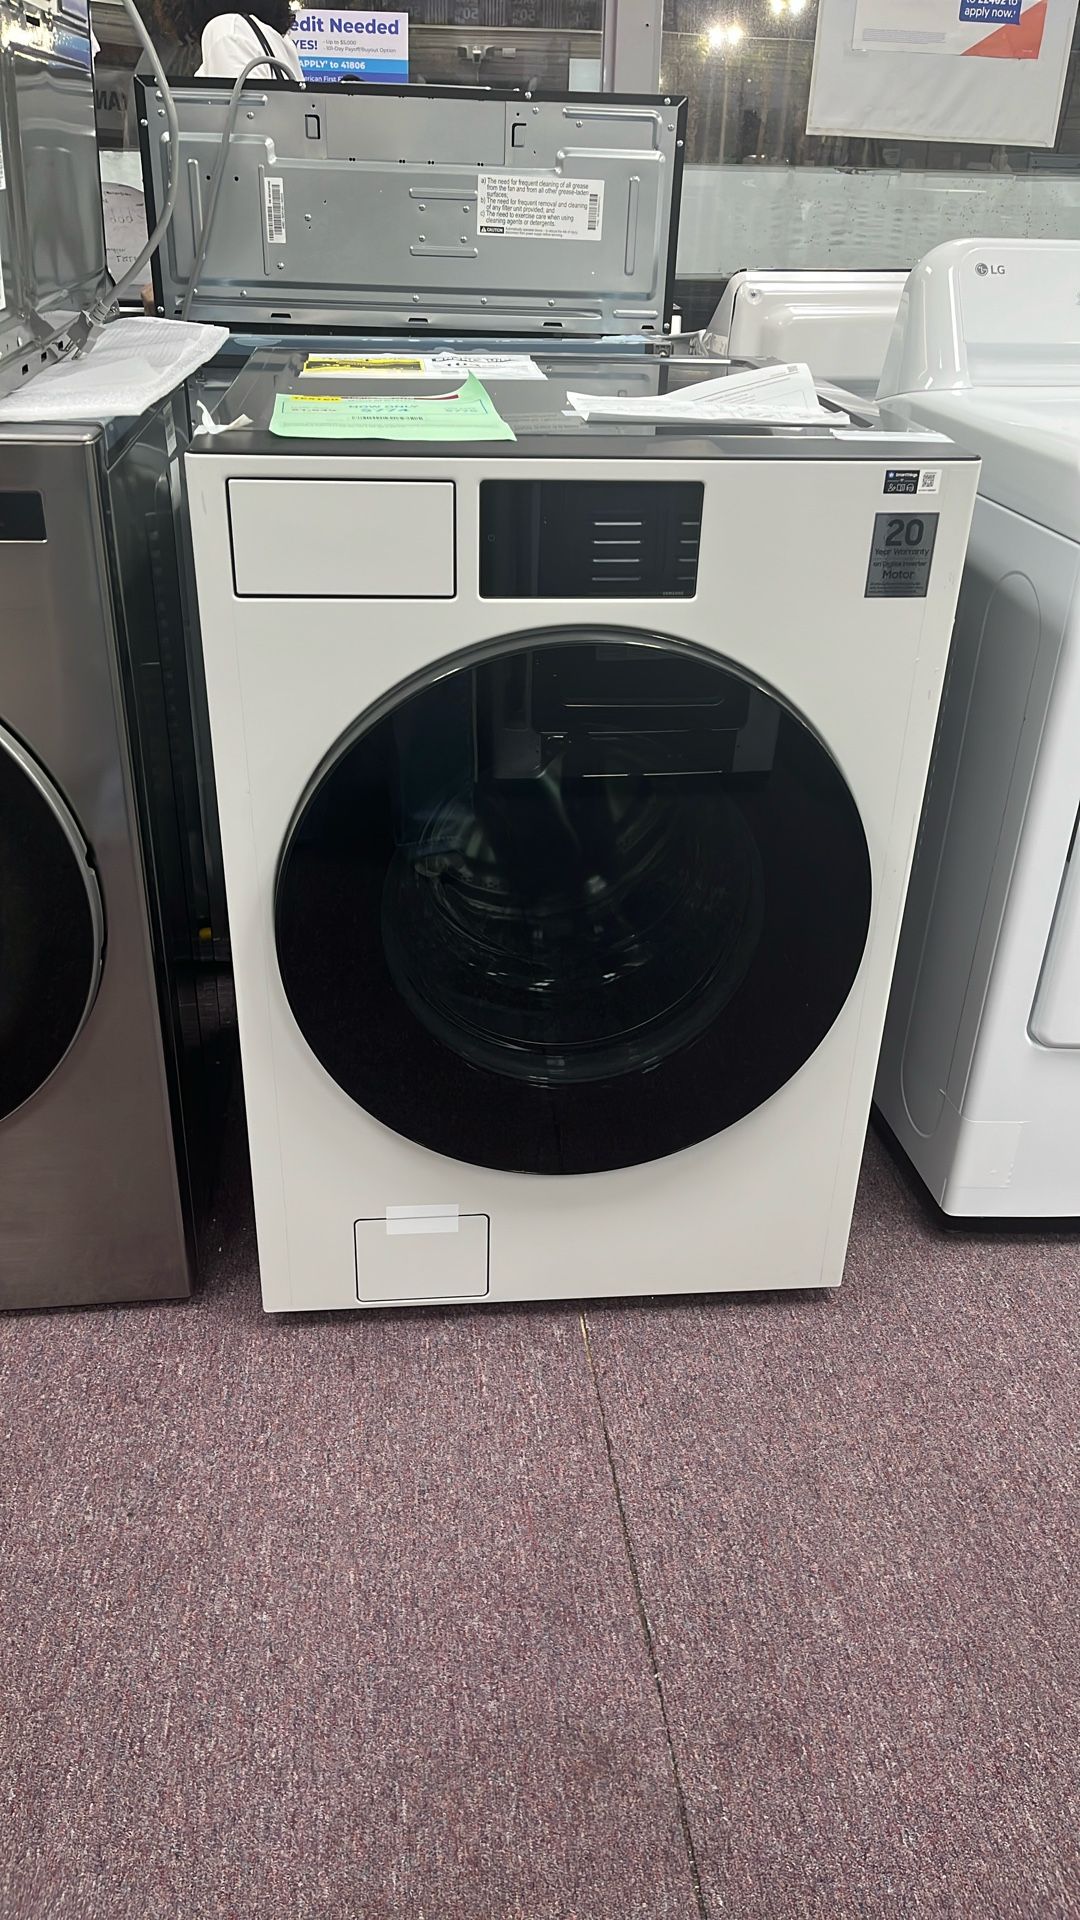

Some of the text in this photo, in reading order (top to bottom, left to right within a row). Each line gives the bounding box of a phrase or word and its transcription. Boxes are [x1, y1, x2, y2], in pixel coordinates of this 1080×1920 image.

[964, 7, 990, 19] apply
[329, 18, 399, 35] Needed
[292, 39, 318, 50] YES!
[330, 61, 339, 69] to
[341, 61, 366, 70] 41806
[487, 177, 497, 185] The
[518, 180, 538, 188] frequent
[538, 180, 559, 189] cleaning
[517, 199, 538, 207] frequent
[567, 202, 588, 210] cleaning
[561, 215, 574, 223] using
[990, 265, 1006, 275] LG
[885, 518, 925, 547] 20
[893, 548, 930, 556] Warranty
[882, 570, 915, 580] Motor
